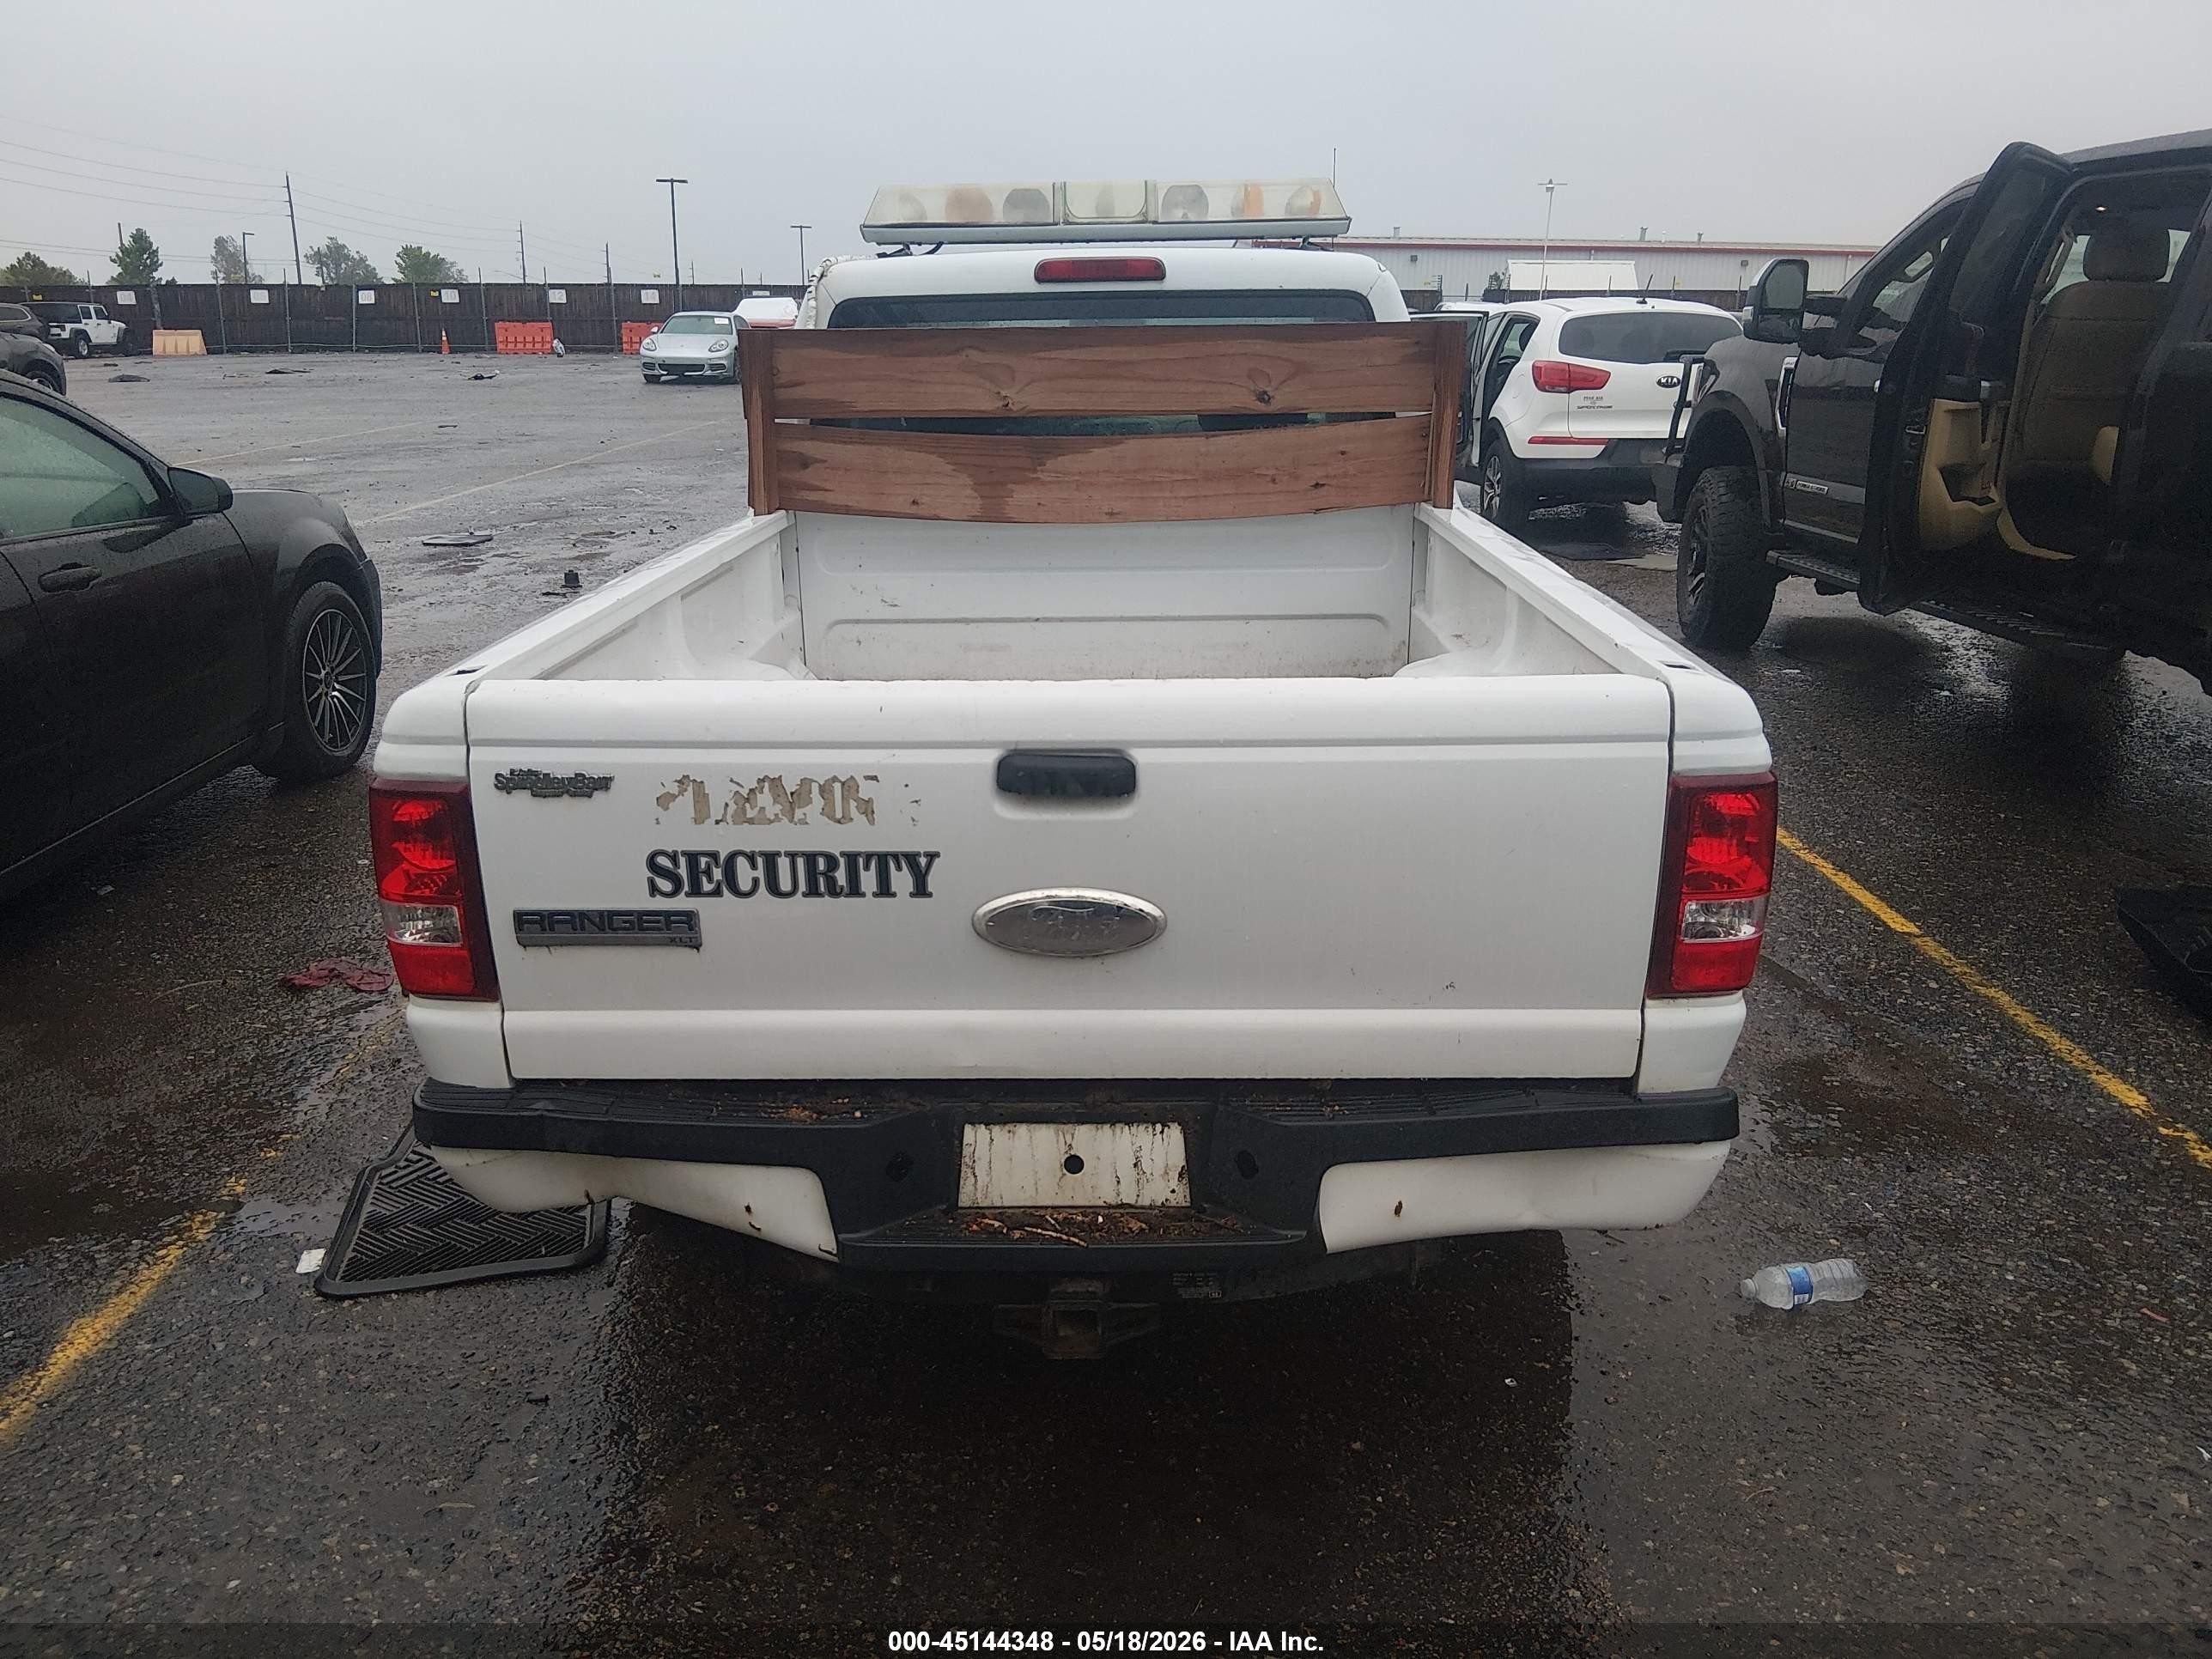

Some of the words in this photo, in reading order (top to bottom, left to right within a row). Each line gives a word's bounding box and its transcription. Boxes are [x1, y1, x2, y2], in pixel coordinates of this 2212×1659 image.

[551, 290, 564, 301] 12
[646, 849, 940, 897] SECURITY
[515, 911, 695, 932] RANGER
